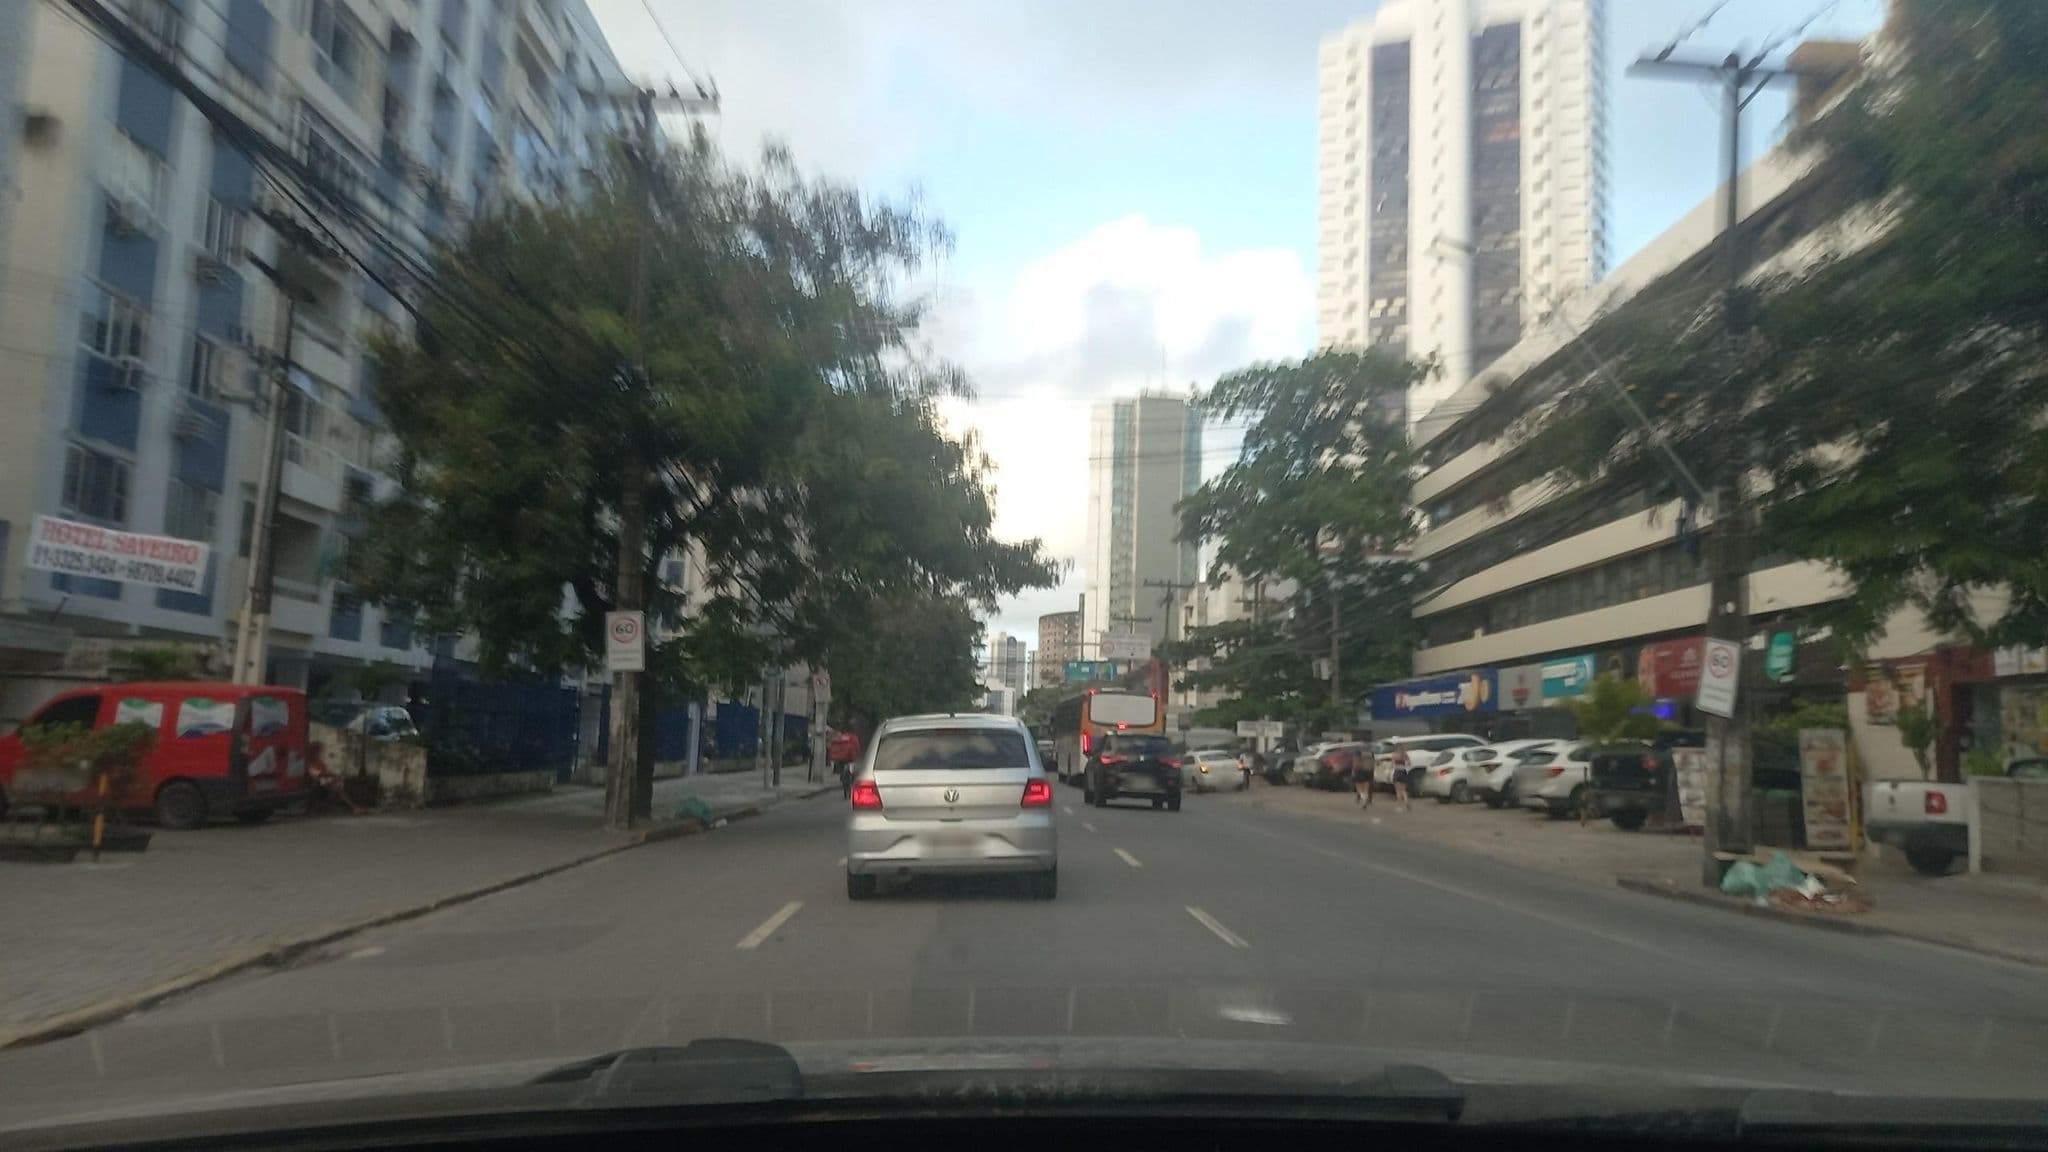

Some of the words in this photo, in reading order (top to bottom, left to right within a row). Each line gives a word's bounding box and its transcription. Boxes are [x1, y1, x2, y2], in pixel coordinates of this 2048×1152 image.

[43, 519, 106, 549] HOTEL
[115, 534, 198, 564] SAVEIRO
[615, 623, 634, 634] 60
[1711, 653, 1730, 669] 60
